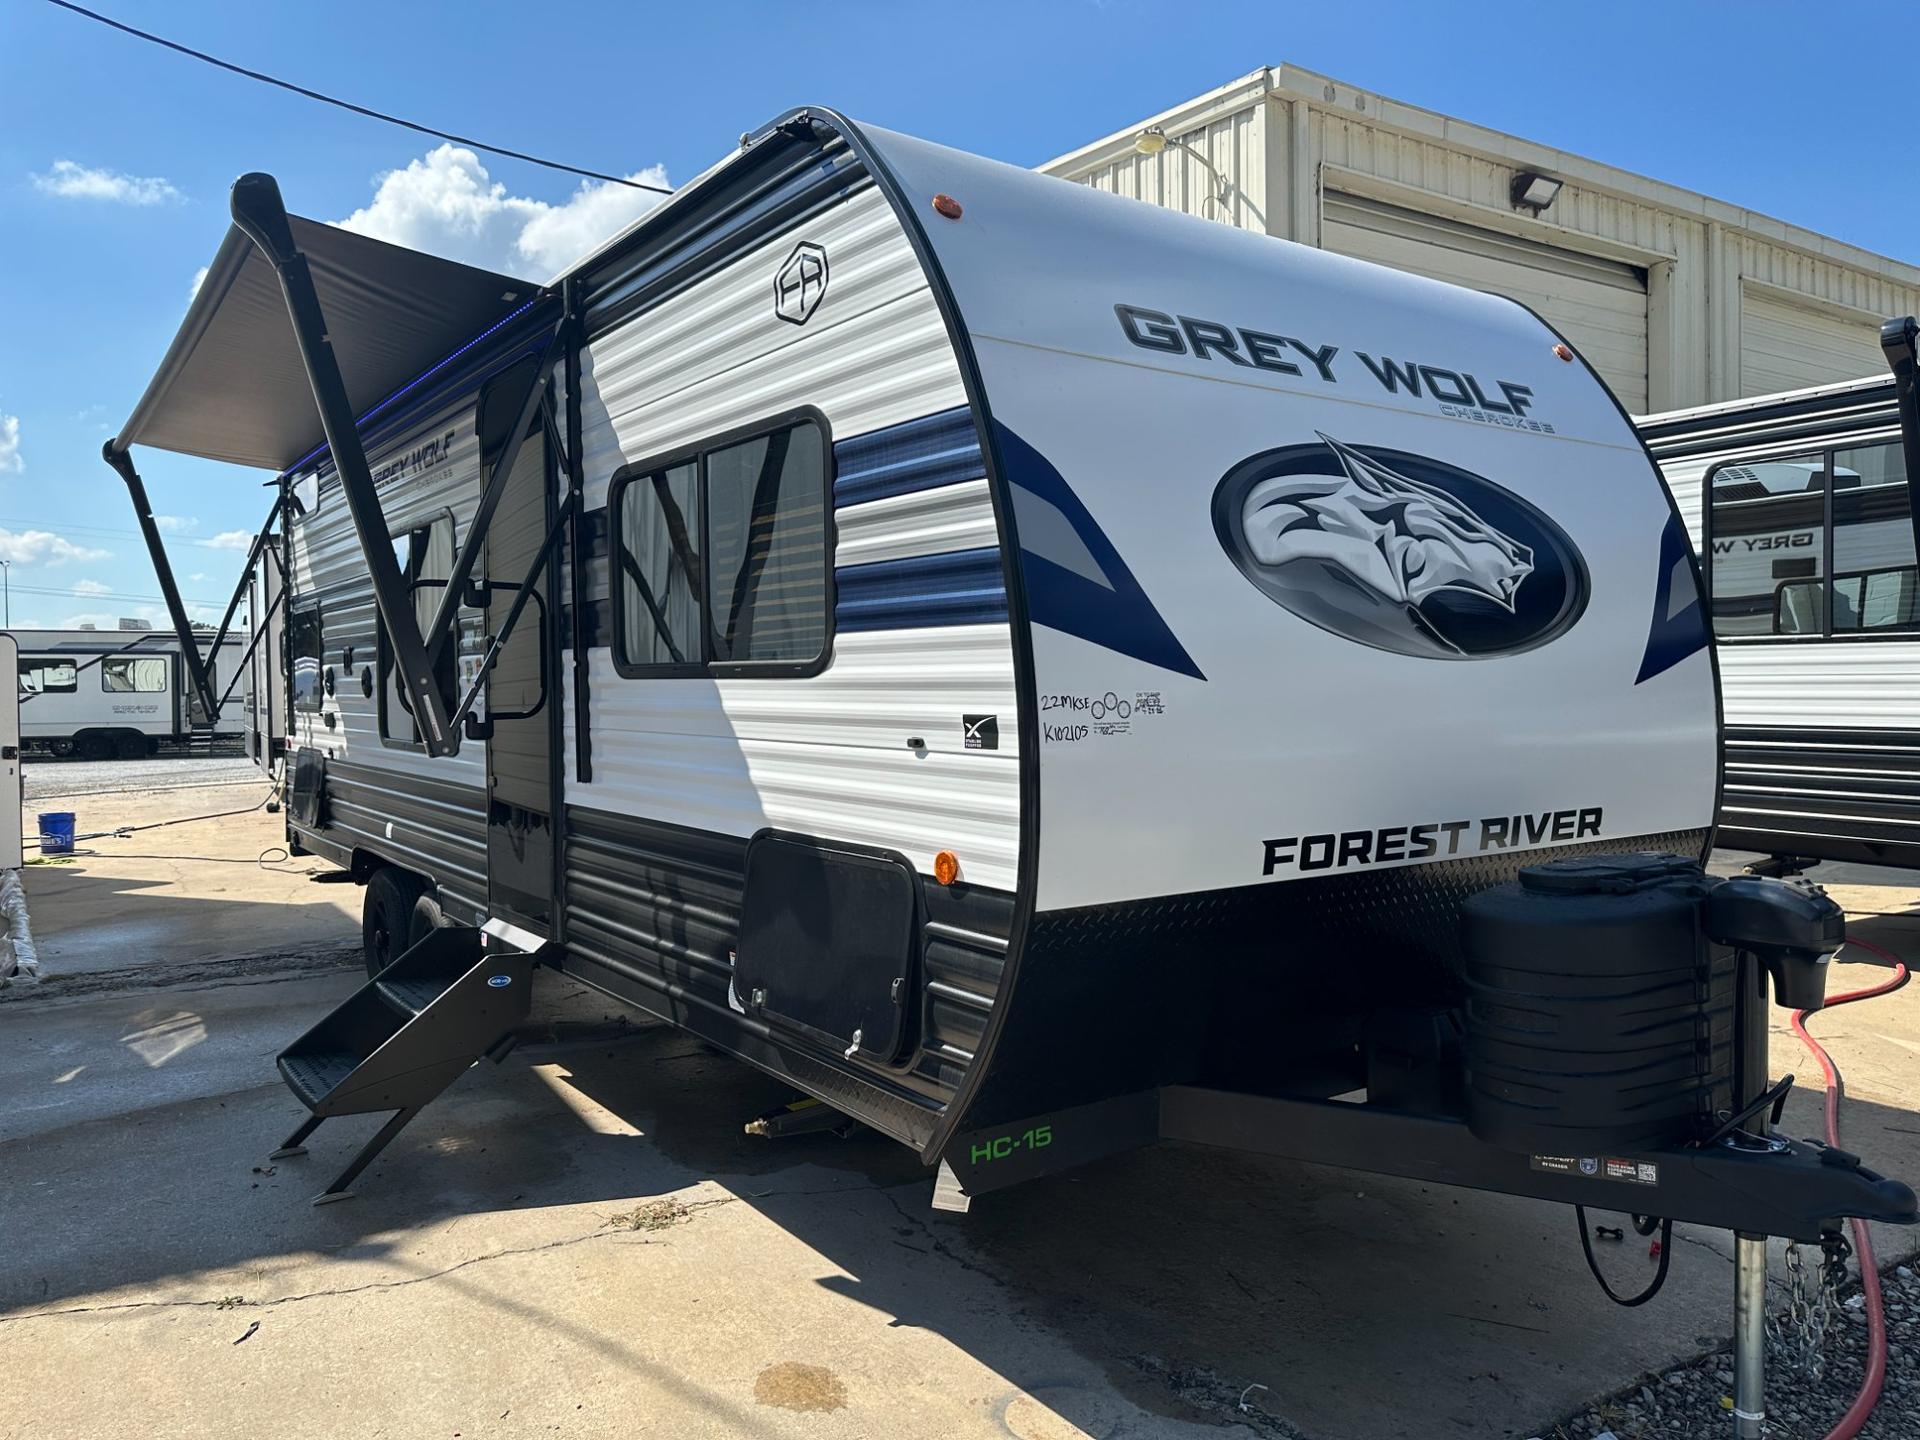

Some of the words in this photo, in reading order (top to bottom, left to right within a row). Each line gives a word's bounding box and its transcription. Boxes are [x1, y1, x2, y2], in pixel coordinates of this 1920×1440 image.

[1114, 303, 1339, 383] GREY
[1354, 351, 1534, 418] WOLF
[1439, 403, 1556, 434] CHEROKEE
[411, 429, 455, 474] WOLF
[1262, 820, 1471, 876] FOREST
[1480, 806, 1603, 851] RIVER
[971, 1125, 1052, 1165] HC-15
